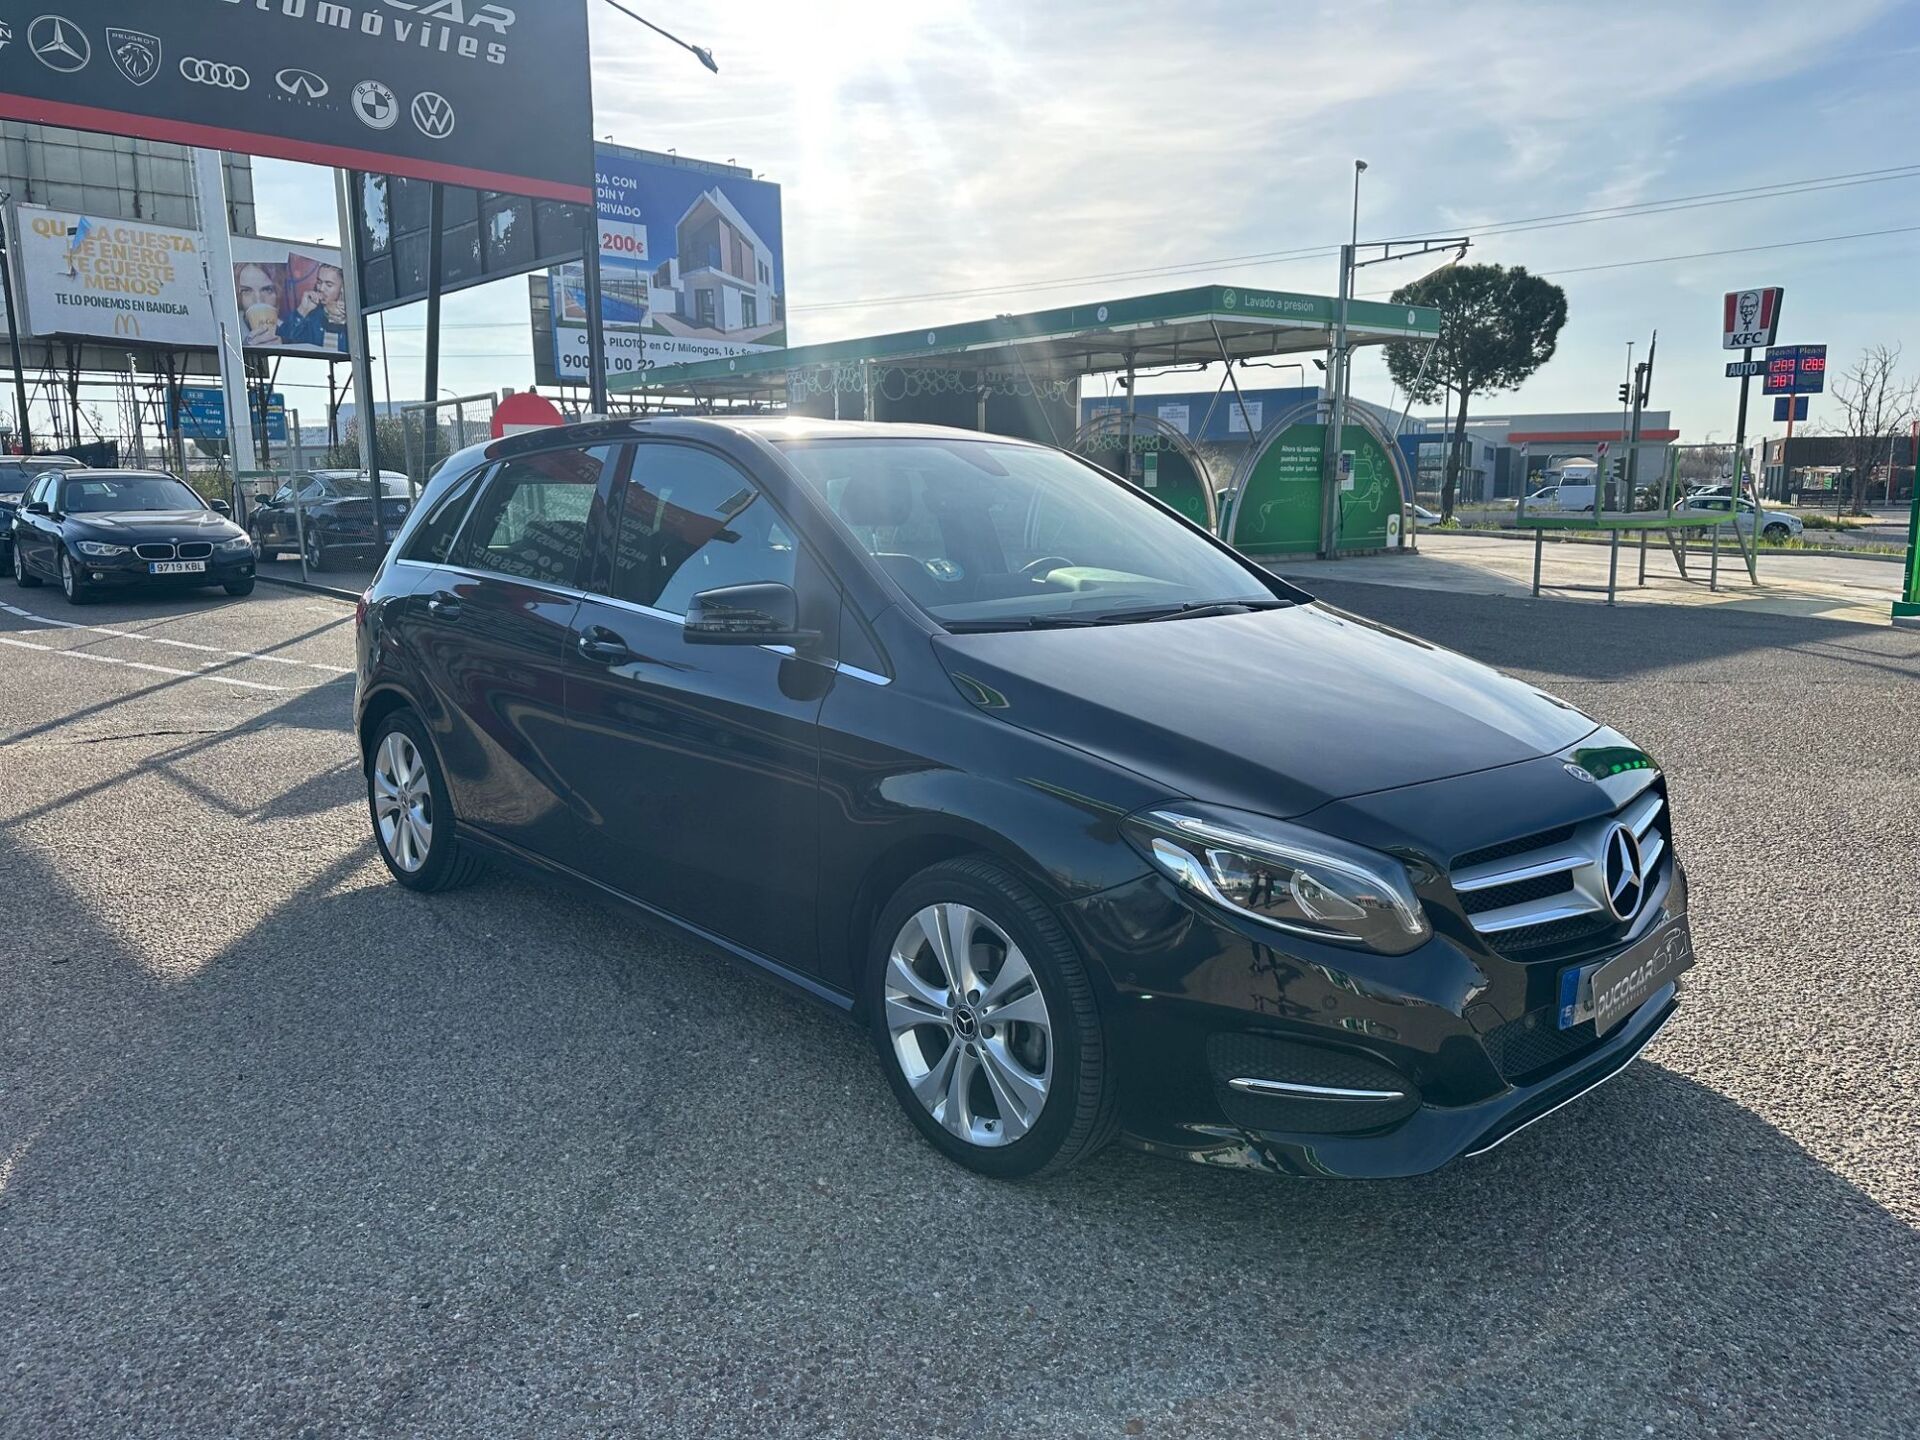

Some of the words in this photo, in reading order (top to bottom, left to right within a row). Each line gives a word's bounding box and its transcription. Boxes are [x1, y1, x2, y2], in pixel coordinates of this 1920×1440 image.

[111, 32, 155, 45] PEUGEOT
[356, 82, 393, 102] BMW
[595, 172, 609, 185] SA
[612, 176, 638, 190] CON
[597, 186, 616, 200] DÍN
[618, 190, 625, 201] Y
[31, 217, 66, 239] QU
[114, 228, 198, 254] CUESTA
[99, 245, 170, 266] ENERO
[94, 257, 175, 283] CUESTE
[83, 275, 160, 296] MENOS
[55, 293, 69, 306] TE
[69, 294, 83, 306] LO
[84, 296, 131, 311] PONEMOS
[132, 301, 145, 312] EN
[147, 303, 190, 316] BANDEJA
[1244, 295, 1276, 309] Lavado
[1277, 300, 1283, 309] a
[1284, 300, 1314, 312] presión
[609, 337, 647, 349] PILOTO
[663, 342, 676, 352] C/
[678, 343, 722, 356] Milongas,
[724, 347, 735, 356] 16
[1730, 332, 1762, 346] KFC
[614, 357, 633, 371] 00
[1728, 362, 1757, 376] AUTO
[157, 563, 183, 572] 9719
[185, 562, 203, 572] KBL
